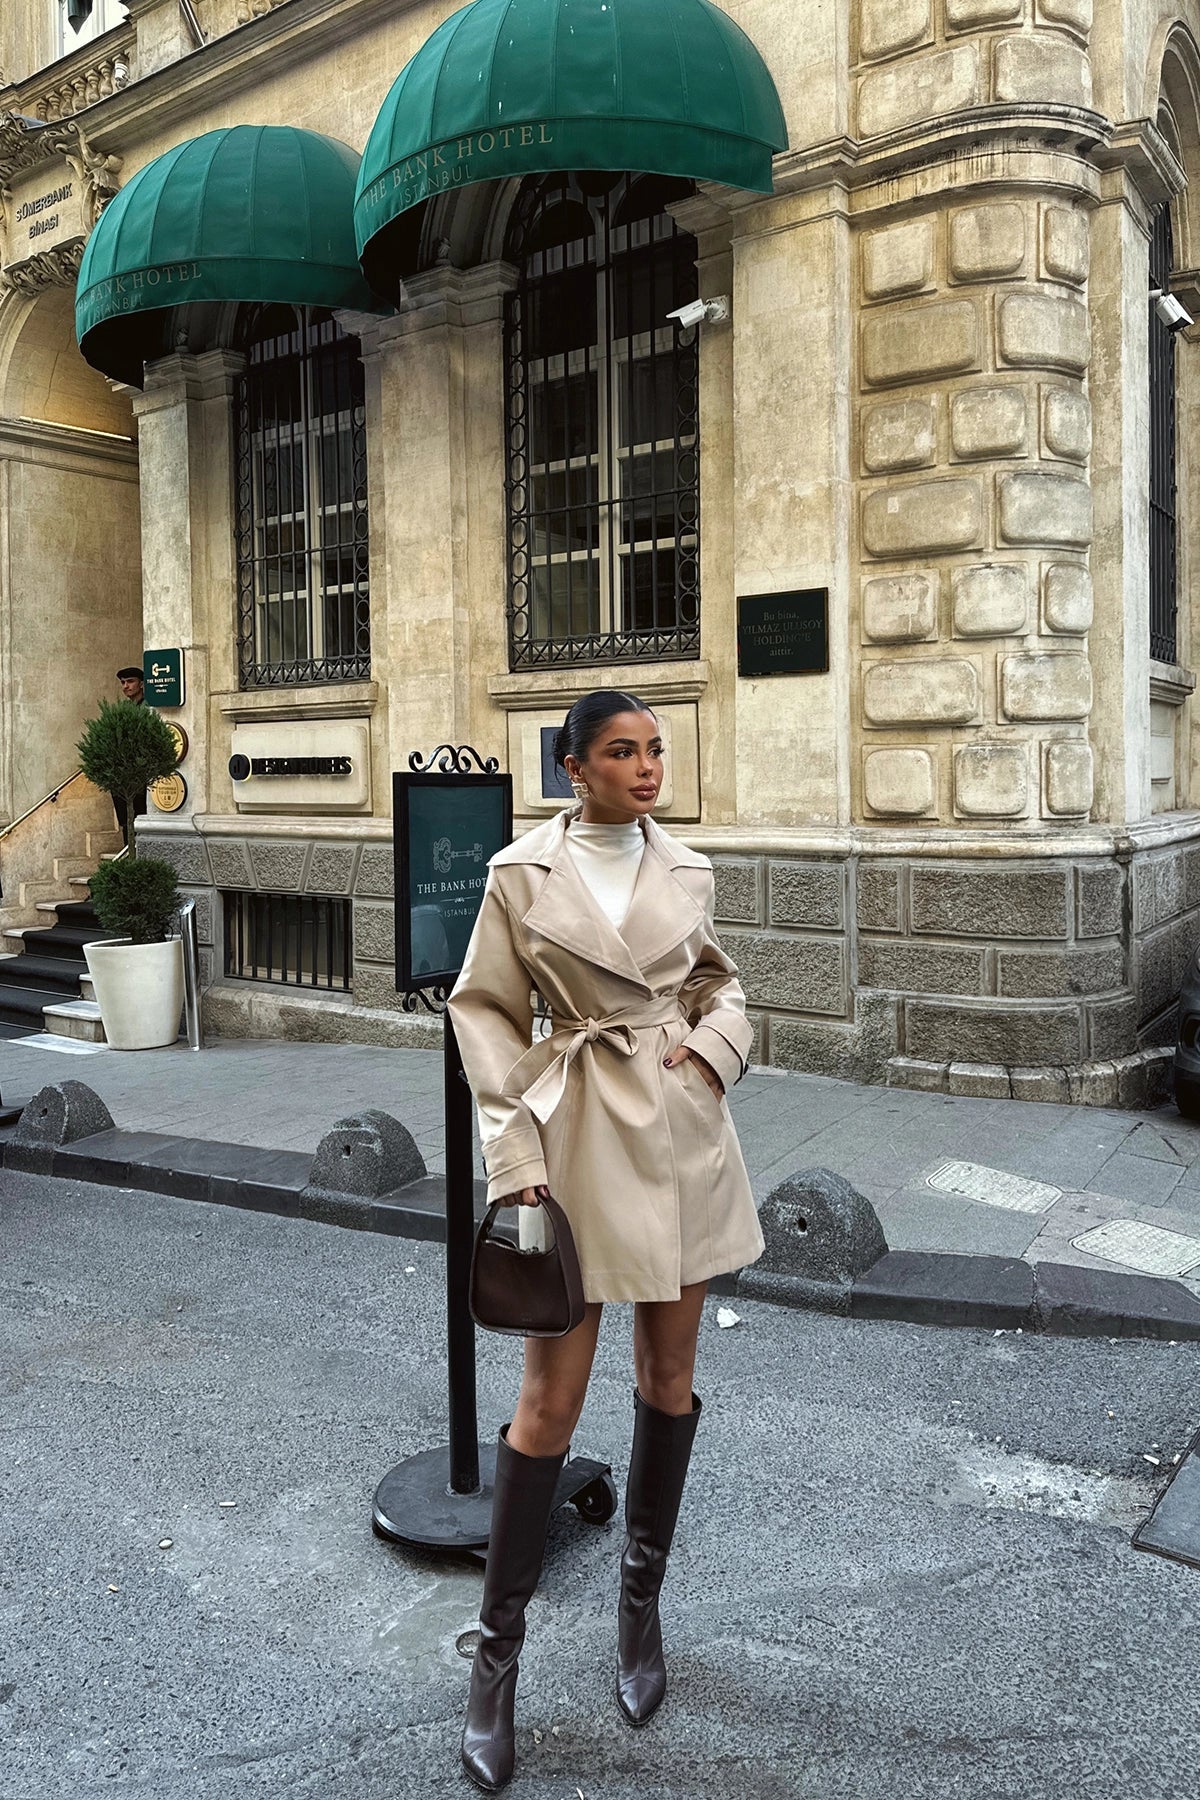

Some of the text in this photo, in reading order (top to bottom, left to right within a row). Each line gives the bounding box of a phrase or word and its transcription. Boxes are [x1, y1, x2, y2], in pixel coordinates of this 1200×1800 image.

[362, 123, 553, 213] THE BANK HOTEL
[399, 164, 472, 207] ISTANBUL
[131, 262, 202, 290] HOTEL
[763, 611, 775, 621] Bu
[742, 619, 823, 635] YILMAZ ULUSOY
[416, 877, 487, 894] THE BANK HOT
[444, 907, 475, 918] ISTANBUL
